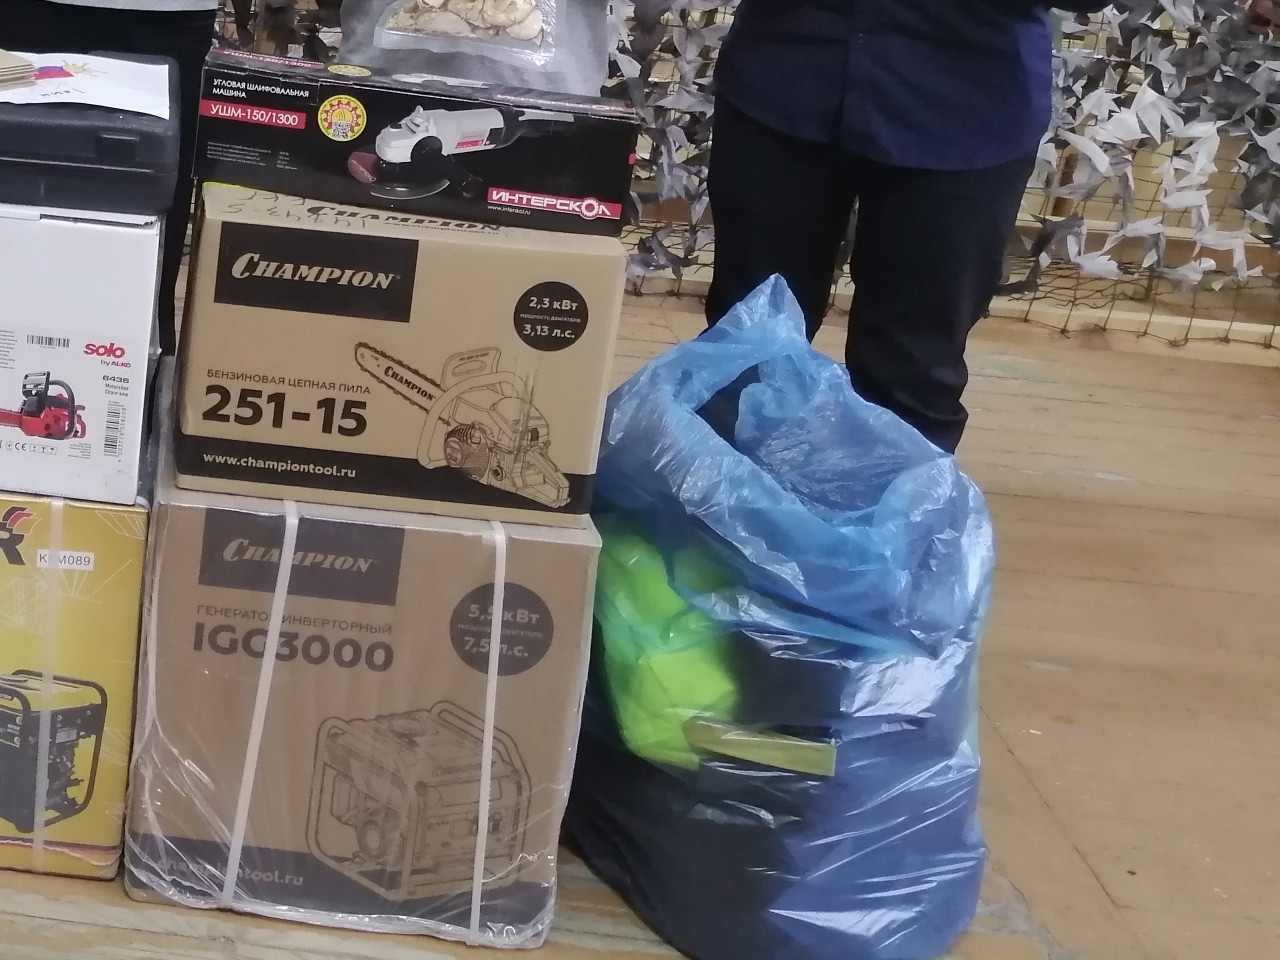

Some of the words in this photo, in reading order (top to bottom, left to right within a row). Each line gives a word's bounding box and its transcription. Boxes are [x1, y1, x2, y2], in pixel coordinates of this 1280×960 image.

[213, 79, 246, 90] УГЛОВАЯ
[247, 83, 310, 98] ШЛИФОВАЛЬНАЯ
[213, 88, 247, 99] МАШИНА
[211, 104, 299, 126] УШМ-150/1300
[492, 190, 612, 218] ИНТЕРСКОЛ
[306, 206, 501, 232] CHAMPION
[231, 252, 396, 290] CHAMPION
[529, 297, 550, 309] 2,3
[553, 300, 578, 311] кВт
[523, 324, 549, 336] 3,13
[552, 329, 575, 338] л.с.
[84, 343, 125, 358] solo
[103, 375, 130, 384] 6436
[207, 369, 285, 385] БЕНЗИНОВАЯ
[288, 378, 336, 392] ЦЕПНАЯ
[338, 383, 371, 395] ПИЛА
[384, 365, 435, 402] CHAMPION
[202, 384, 367, 437] 251-15
[203, 453, 356, 478] www.championtool.ru
[39, 553, 91, 566] KM089
[196, 604, 272, 622] ГЕНЕРАТО
[503, 609, 540, 624] кВт
